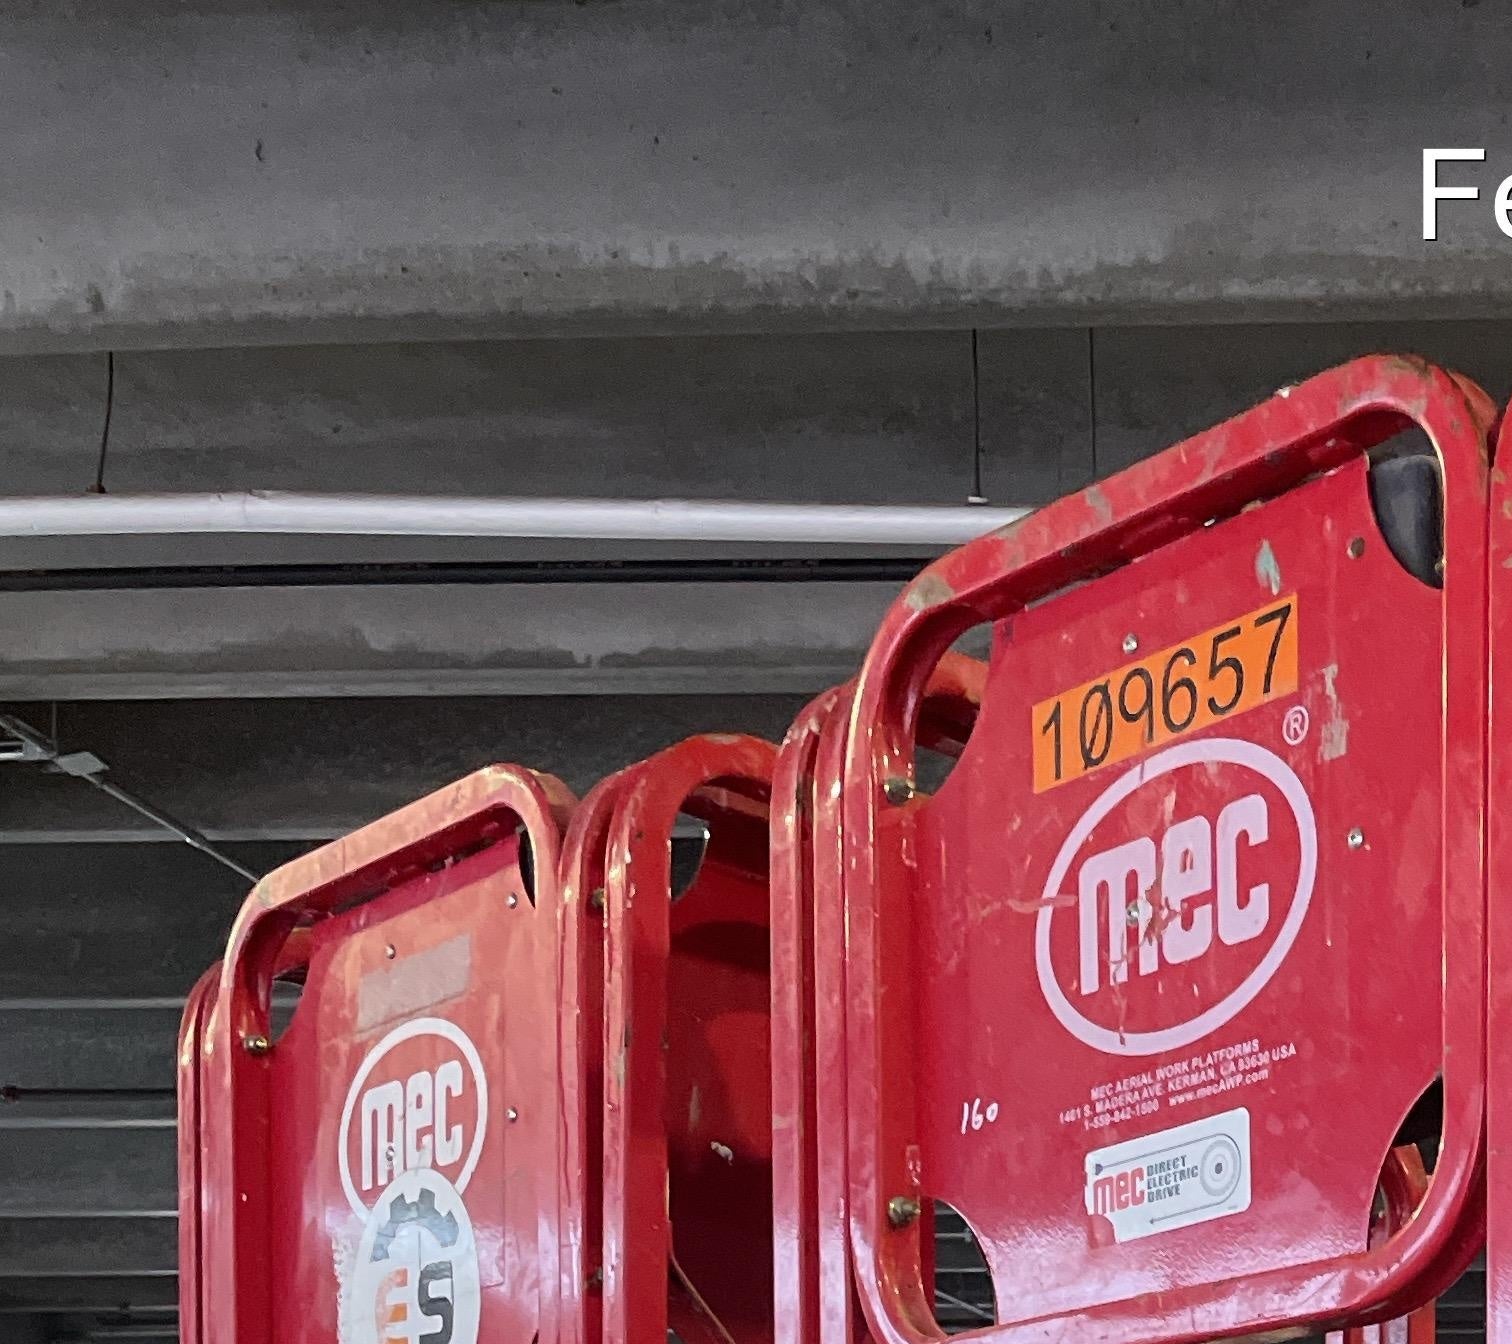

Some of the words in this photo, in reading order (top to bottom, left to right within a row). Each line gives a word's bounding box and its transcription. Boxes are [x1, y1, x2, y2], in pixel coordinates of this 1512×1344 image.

[1039, 604, 1293, 782] 109657
[1271, 1042, 1297, 1062] USA
[1115, 1072, 1153, 1094] AERIAL
[1156, 1060, 1189, 1081] WORK
[1192, 1038, 1260, 1070] PLATFORMS
[960, 1097, 999, 1135] 160
[1146, 1154, 1188, 1177] DIRECT
[1146, 1165, 1199, 1191] ELECTRIC
[1147, 1183, 1182, 1204] DRIVE
